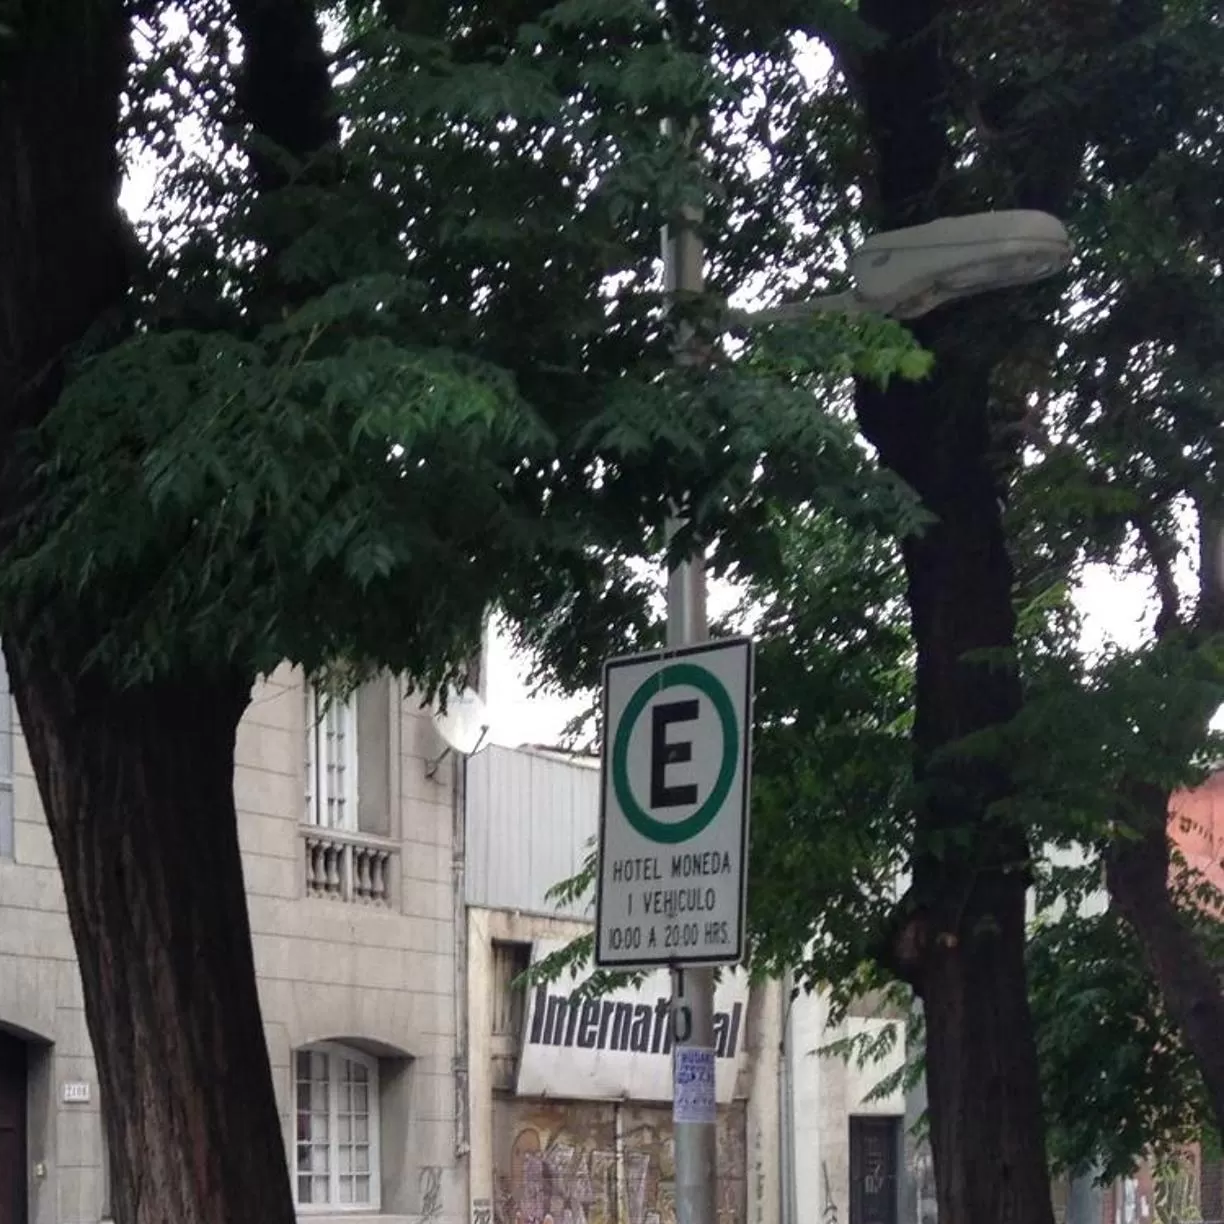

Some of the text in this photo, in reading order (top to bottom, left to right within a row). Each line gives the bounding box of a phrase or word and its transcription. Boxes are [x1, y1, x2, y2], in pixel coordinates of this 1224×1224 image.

[649, 699, 700, 809] E
[613, 851, 731, 883] HOTEL MONEDA
[643, 887, 716, 914] VEHICULO
[647, 925, 657, 948] A
